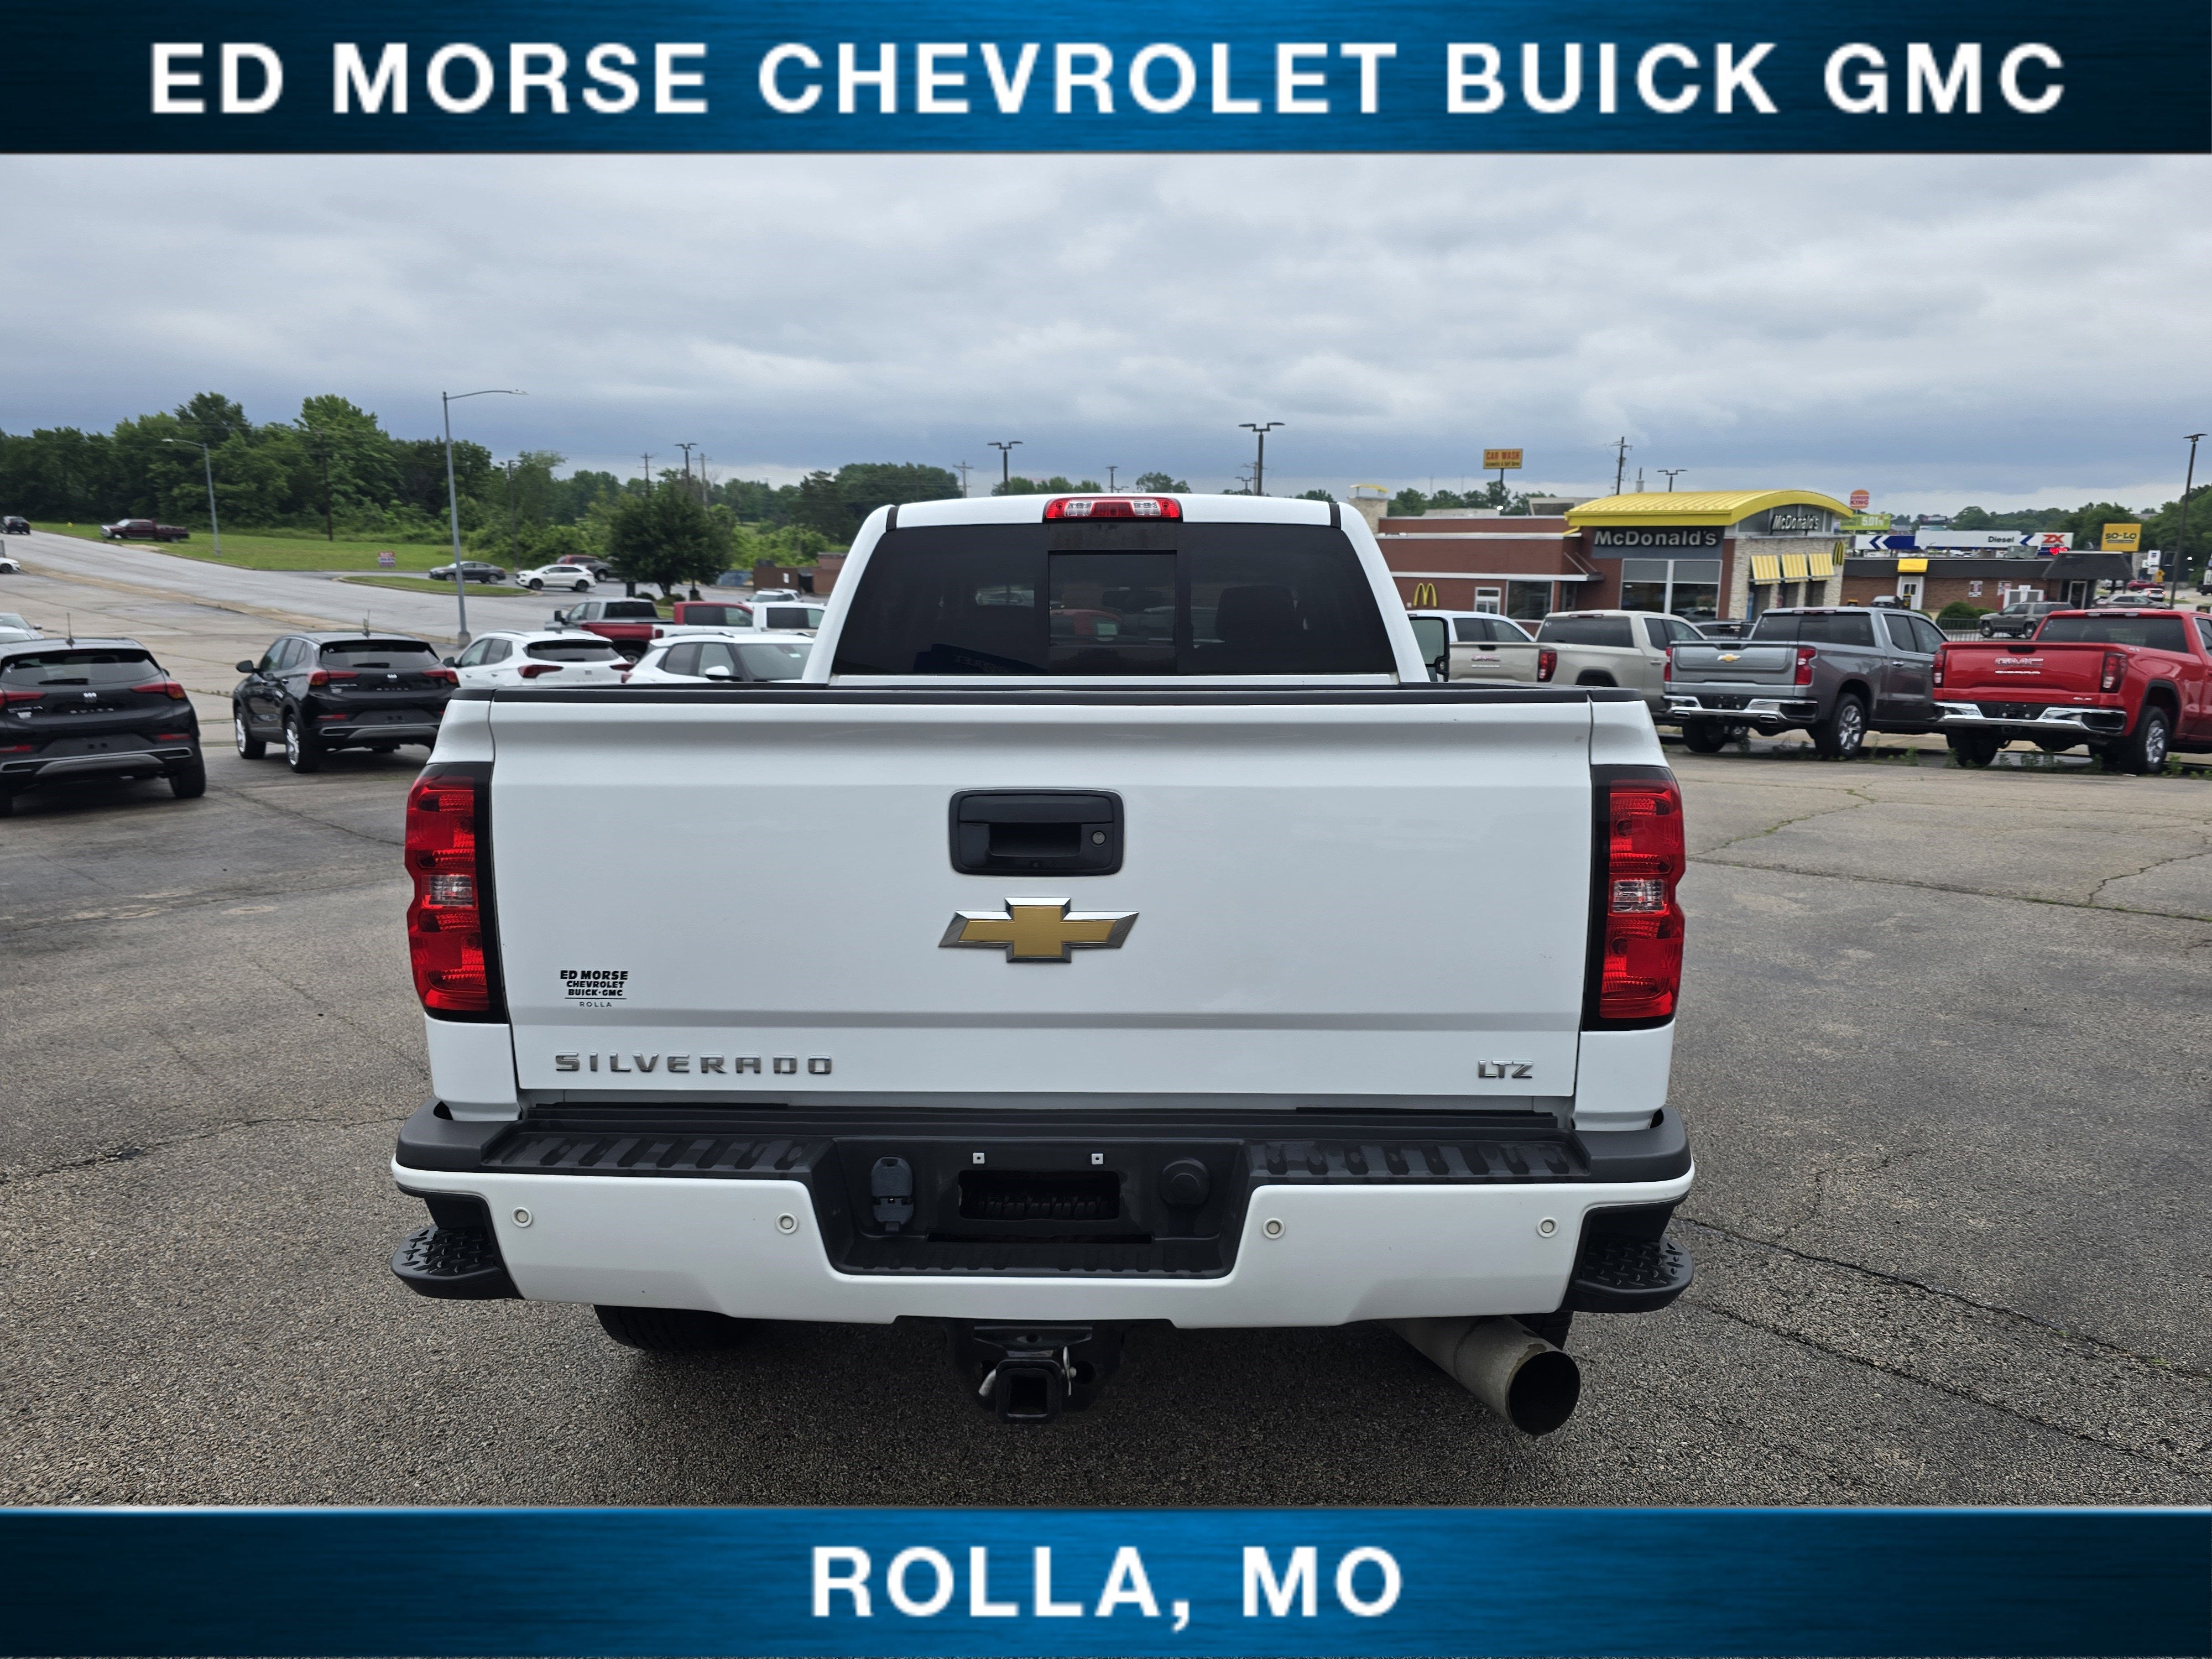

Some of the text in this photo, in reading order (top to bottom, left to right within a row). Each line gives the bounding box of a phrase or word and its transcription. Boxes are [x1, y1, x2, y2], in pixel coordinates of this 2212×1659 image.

[1771, 514, 1819, 530] McDonald's
[1594, 530, 1717, 546] McDonald's
[560, 970, 629, 980] ED MORSE
[555, 1052, 832, 1074] SILVERADO
[1478, 1060, 1533, 1078] LTZ
